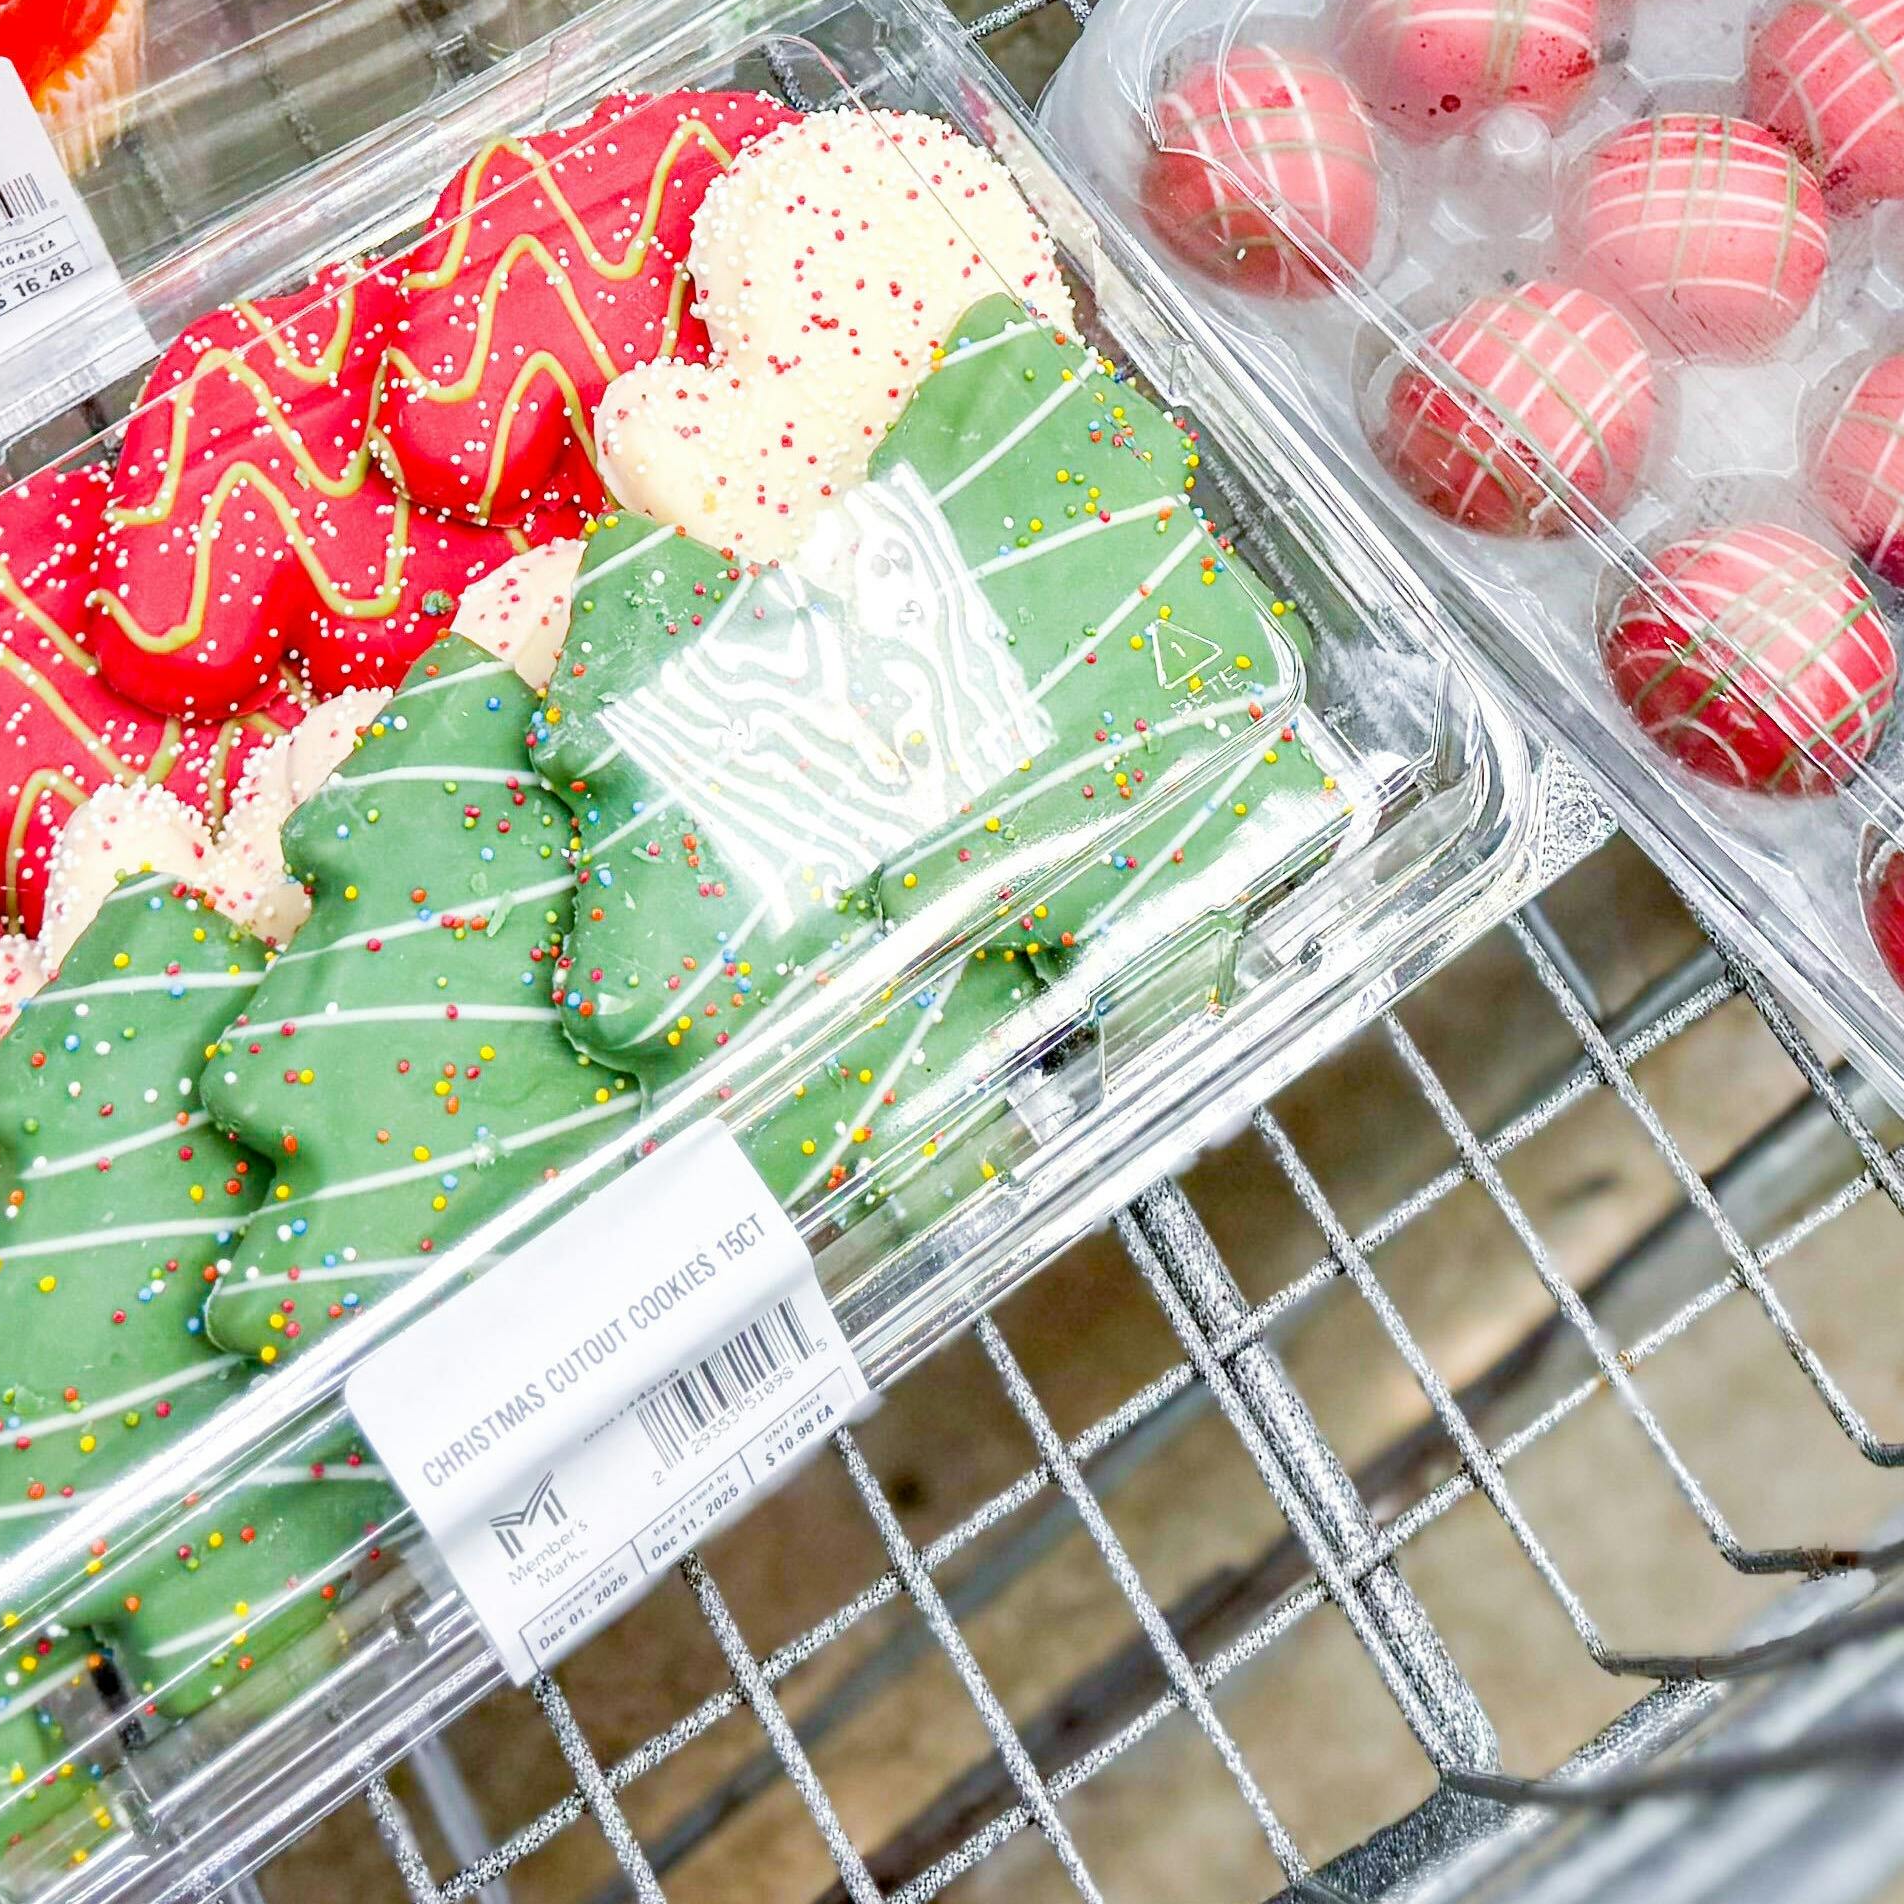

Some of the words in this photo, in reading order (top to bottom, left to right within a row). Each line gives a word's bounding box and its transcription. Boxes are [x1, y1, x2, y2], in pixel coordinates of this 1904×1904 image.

[13, 262, 74, 297] 16.48
[423, 1383, 545, 1486] CHRISTMAS
[546, 1318, 627, 1393] CUTOUT
[629, 1253, 715, 1329] COOKIES
[717, 1213, 764, 1260] 15CT
[651, 1470, 665, 1486] 2
[691, 1408, 739, 1456] 29353
[744, 1366, 794, 1409] 51098
[815, 1337, 828, 1352] 5
[763, 1451, 776, 1467] $
[778, 1419, 814, 1454] 10.98
[815, 1404, 834, 1425] EA
[508, 1520, 588, 1585] Member's
[650, 1534, 678, 1560] Dec
[706, 1484, 738, 1517] 2025
[537, 1551, 580, 1588] Mark
[537, 1622, 567, 1650] Dec
[593, 1572, 629, 1605] 2025
